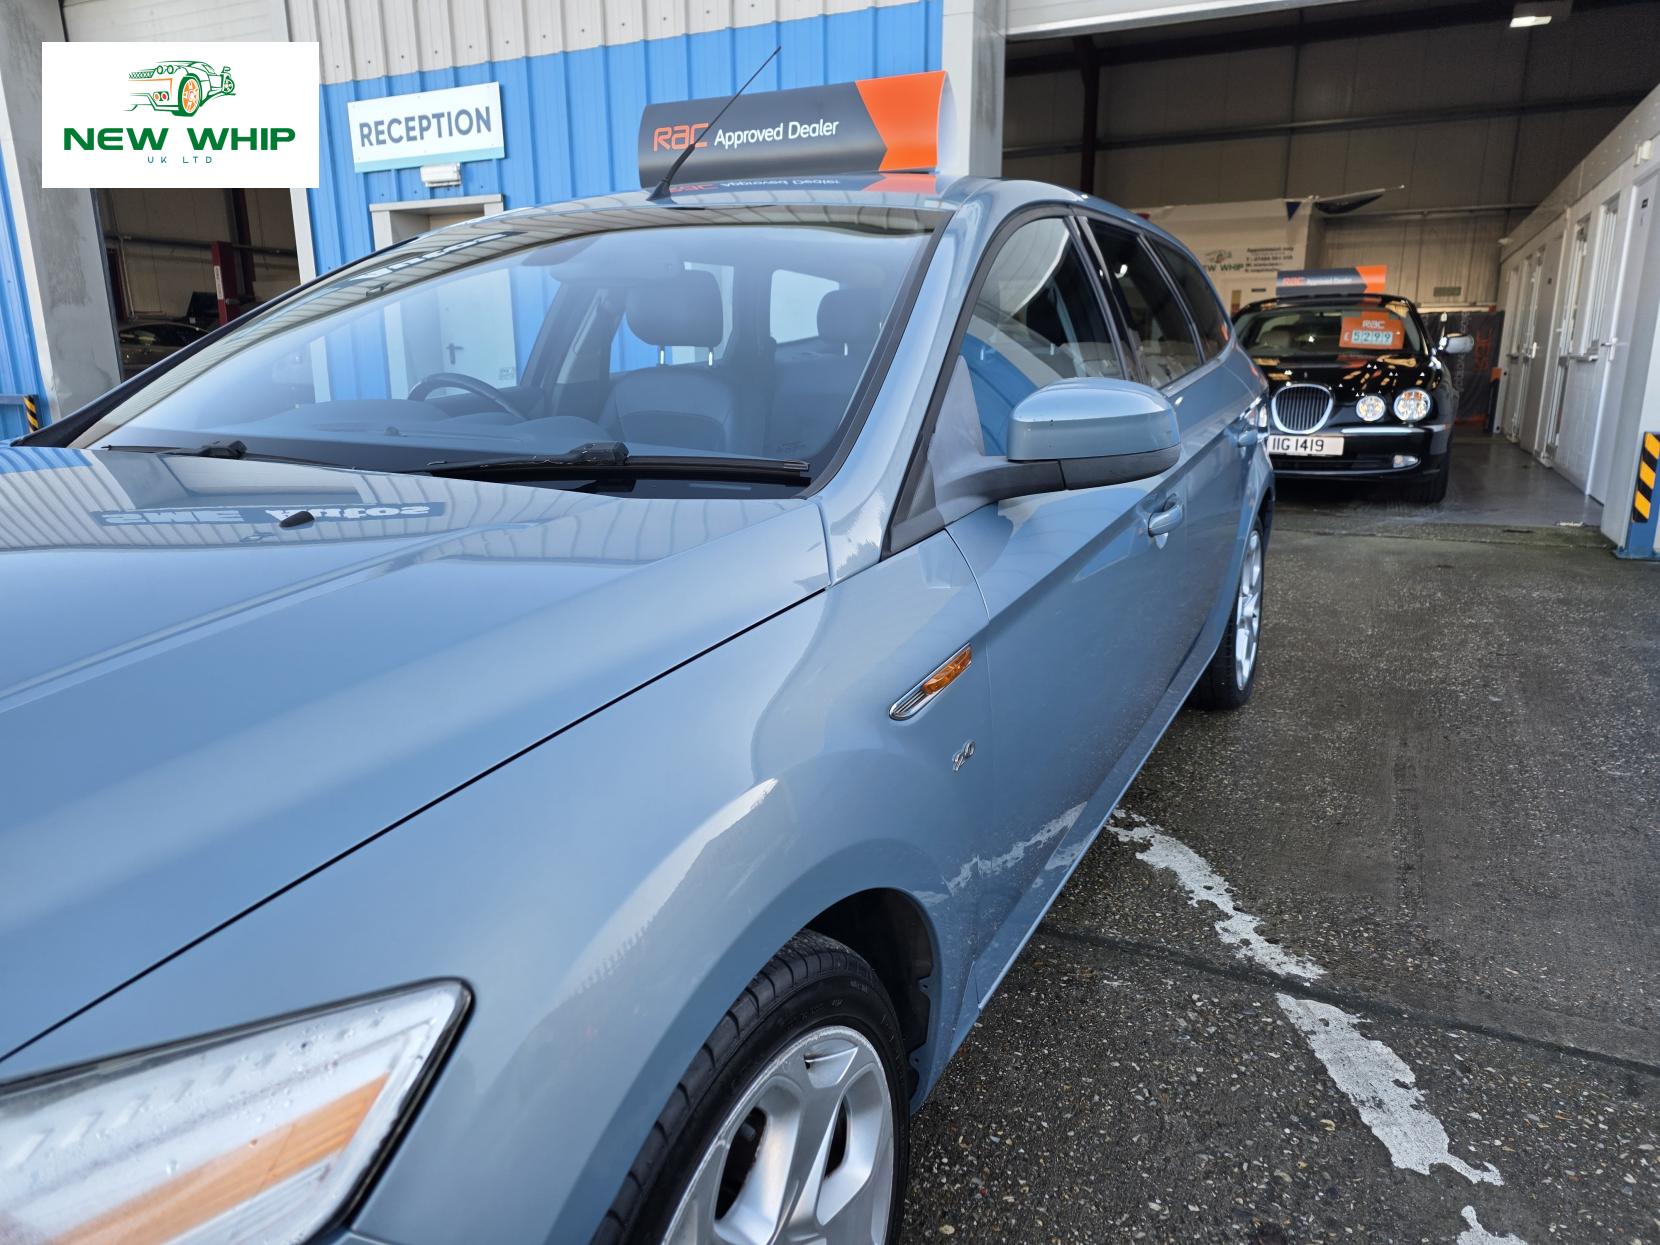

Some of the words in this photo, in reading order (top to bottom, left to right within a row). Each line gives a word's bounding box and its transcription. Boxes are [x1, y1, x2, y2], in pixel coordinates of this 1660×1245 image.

[359, 106, 492, 147] RECEPTION
[714, 122, 783, 149] Approved
[788, 119, 839, 139] Dealer
[1295, 438, 1325, 452] 1419
